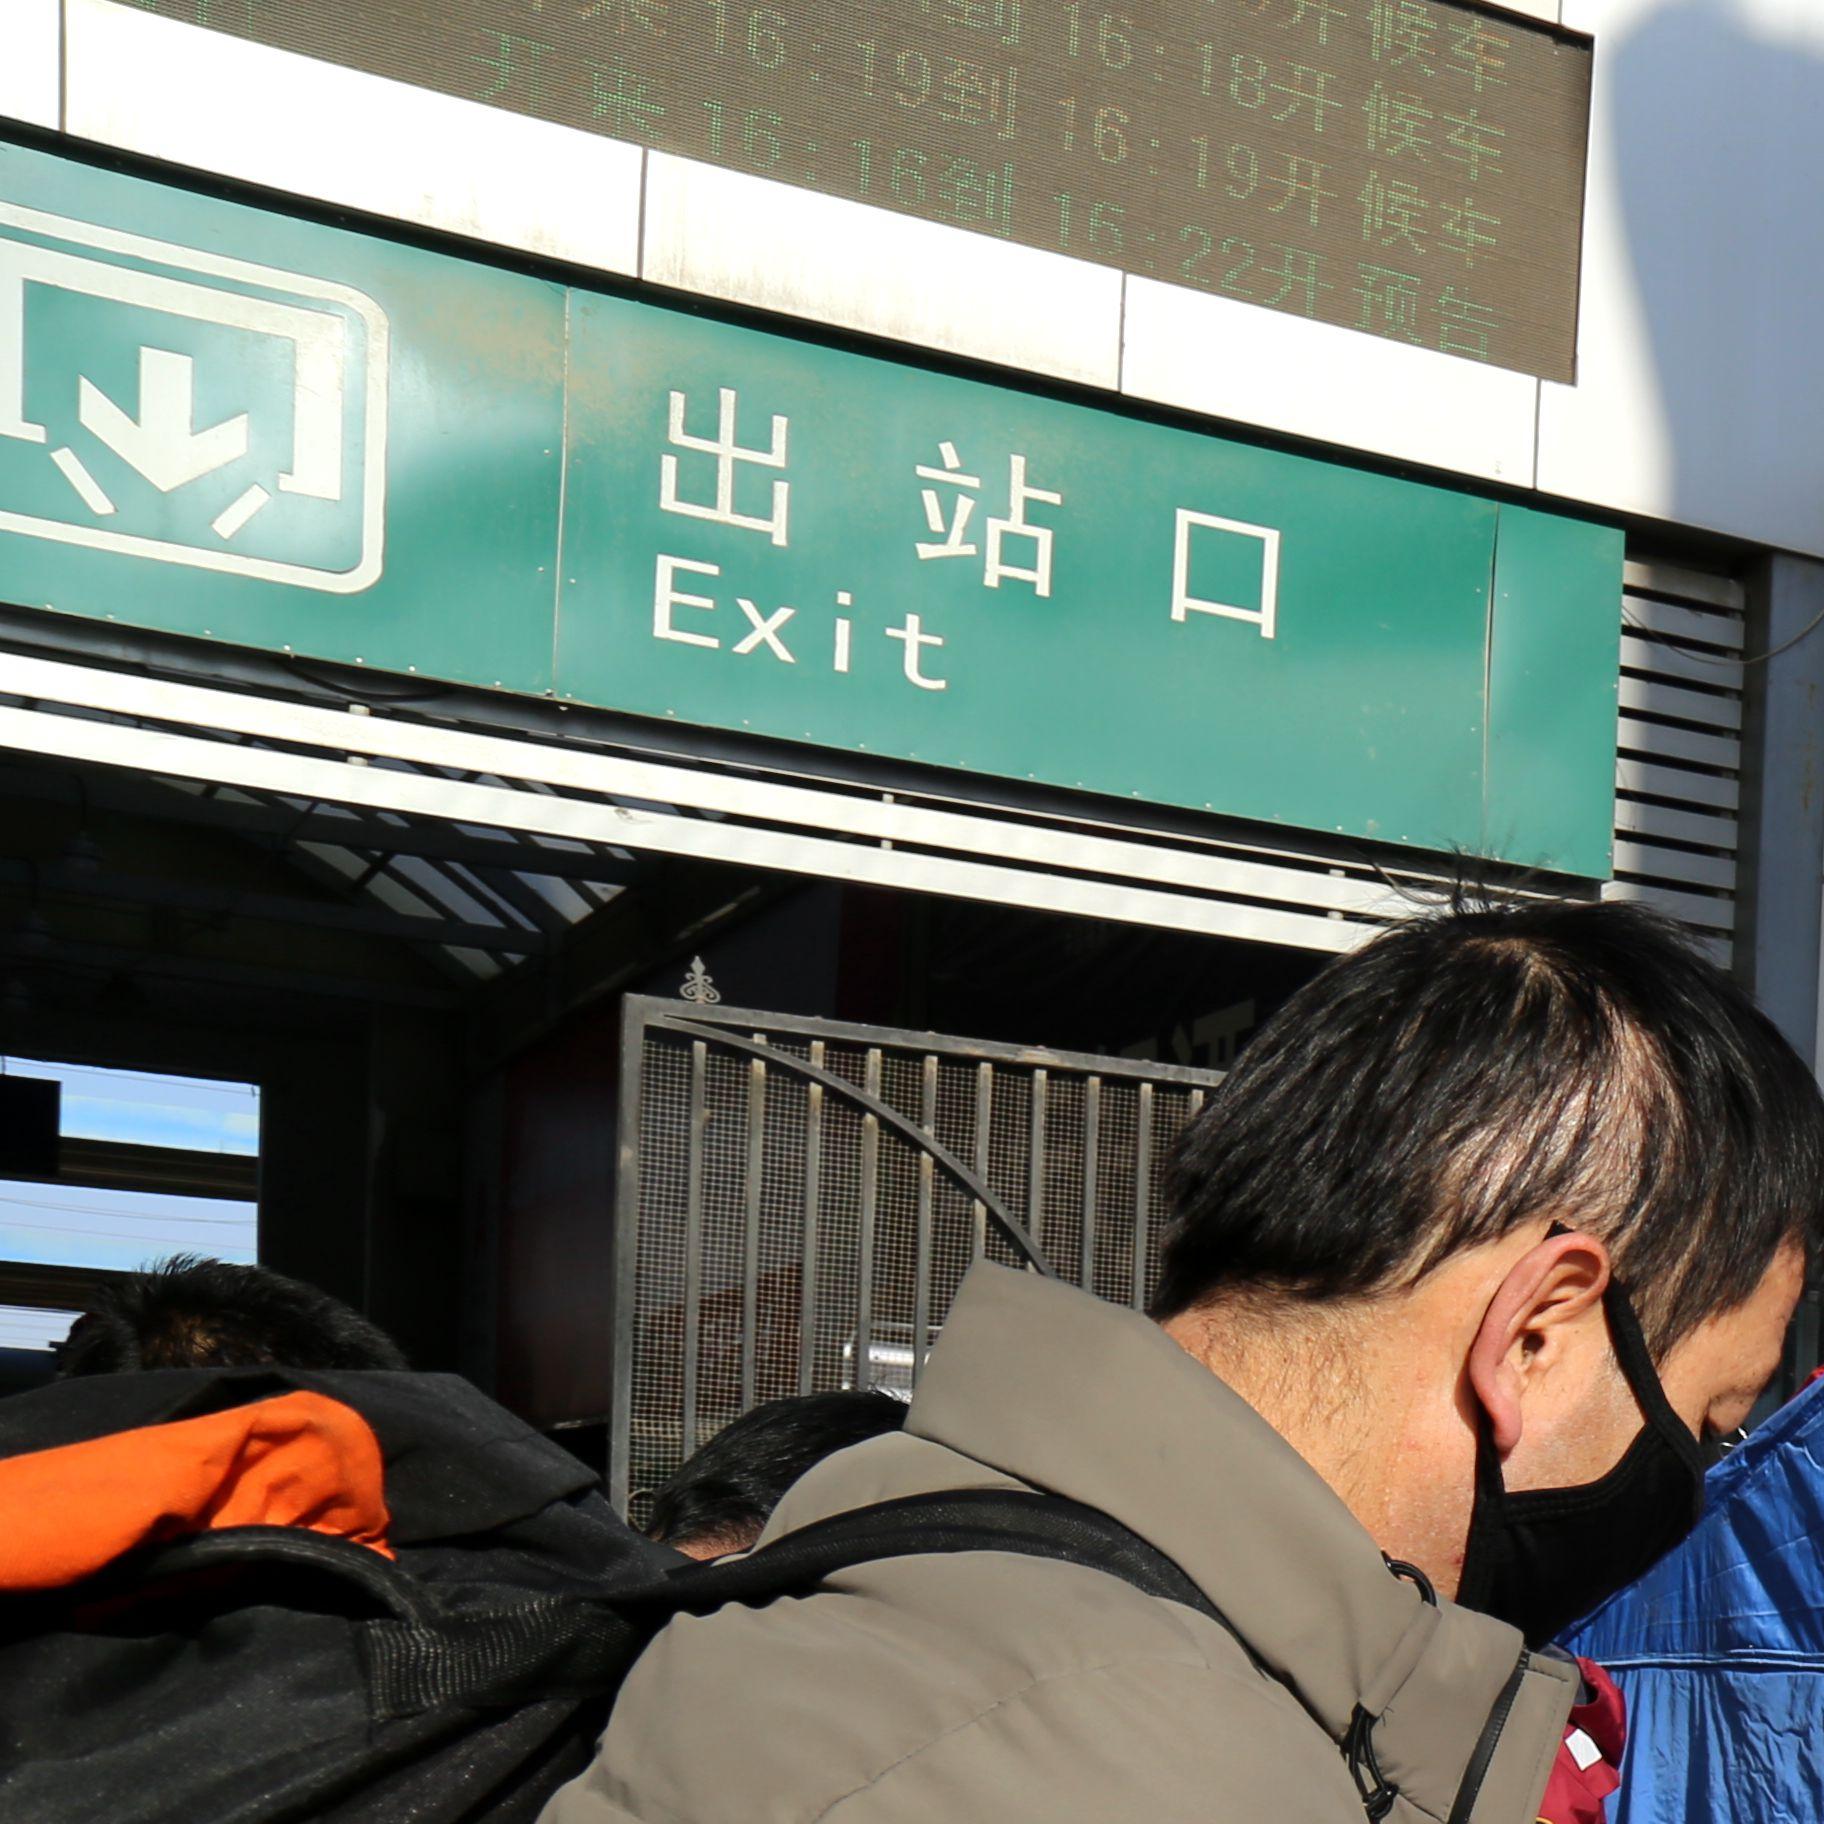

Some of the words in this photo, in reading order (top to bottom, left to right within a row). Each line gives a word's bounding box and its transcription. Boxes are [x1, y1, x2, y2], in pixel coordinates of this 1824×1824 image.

[1058, 97, 1339, 226] 16:19开
[1356, 169, 1502, 269] 候车
[1361, 81, 1507, 181] 候车
[703, 100, 1014, 237] 16:16到
[1054, 194, 1335, 320] 16:22开
[1354, 262, 1501, 360] 预告
[658, 386, 1283, 642] 出站口
[652, 554, 950, 692] Exit
